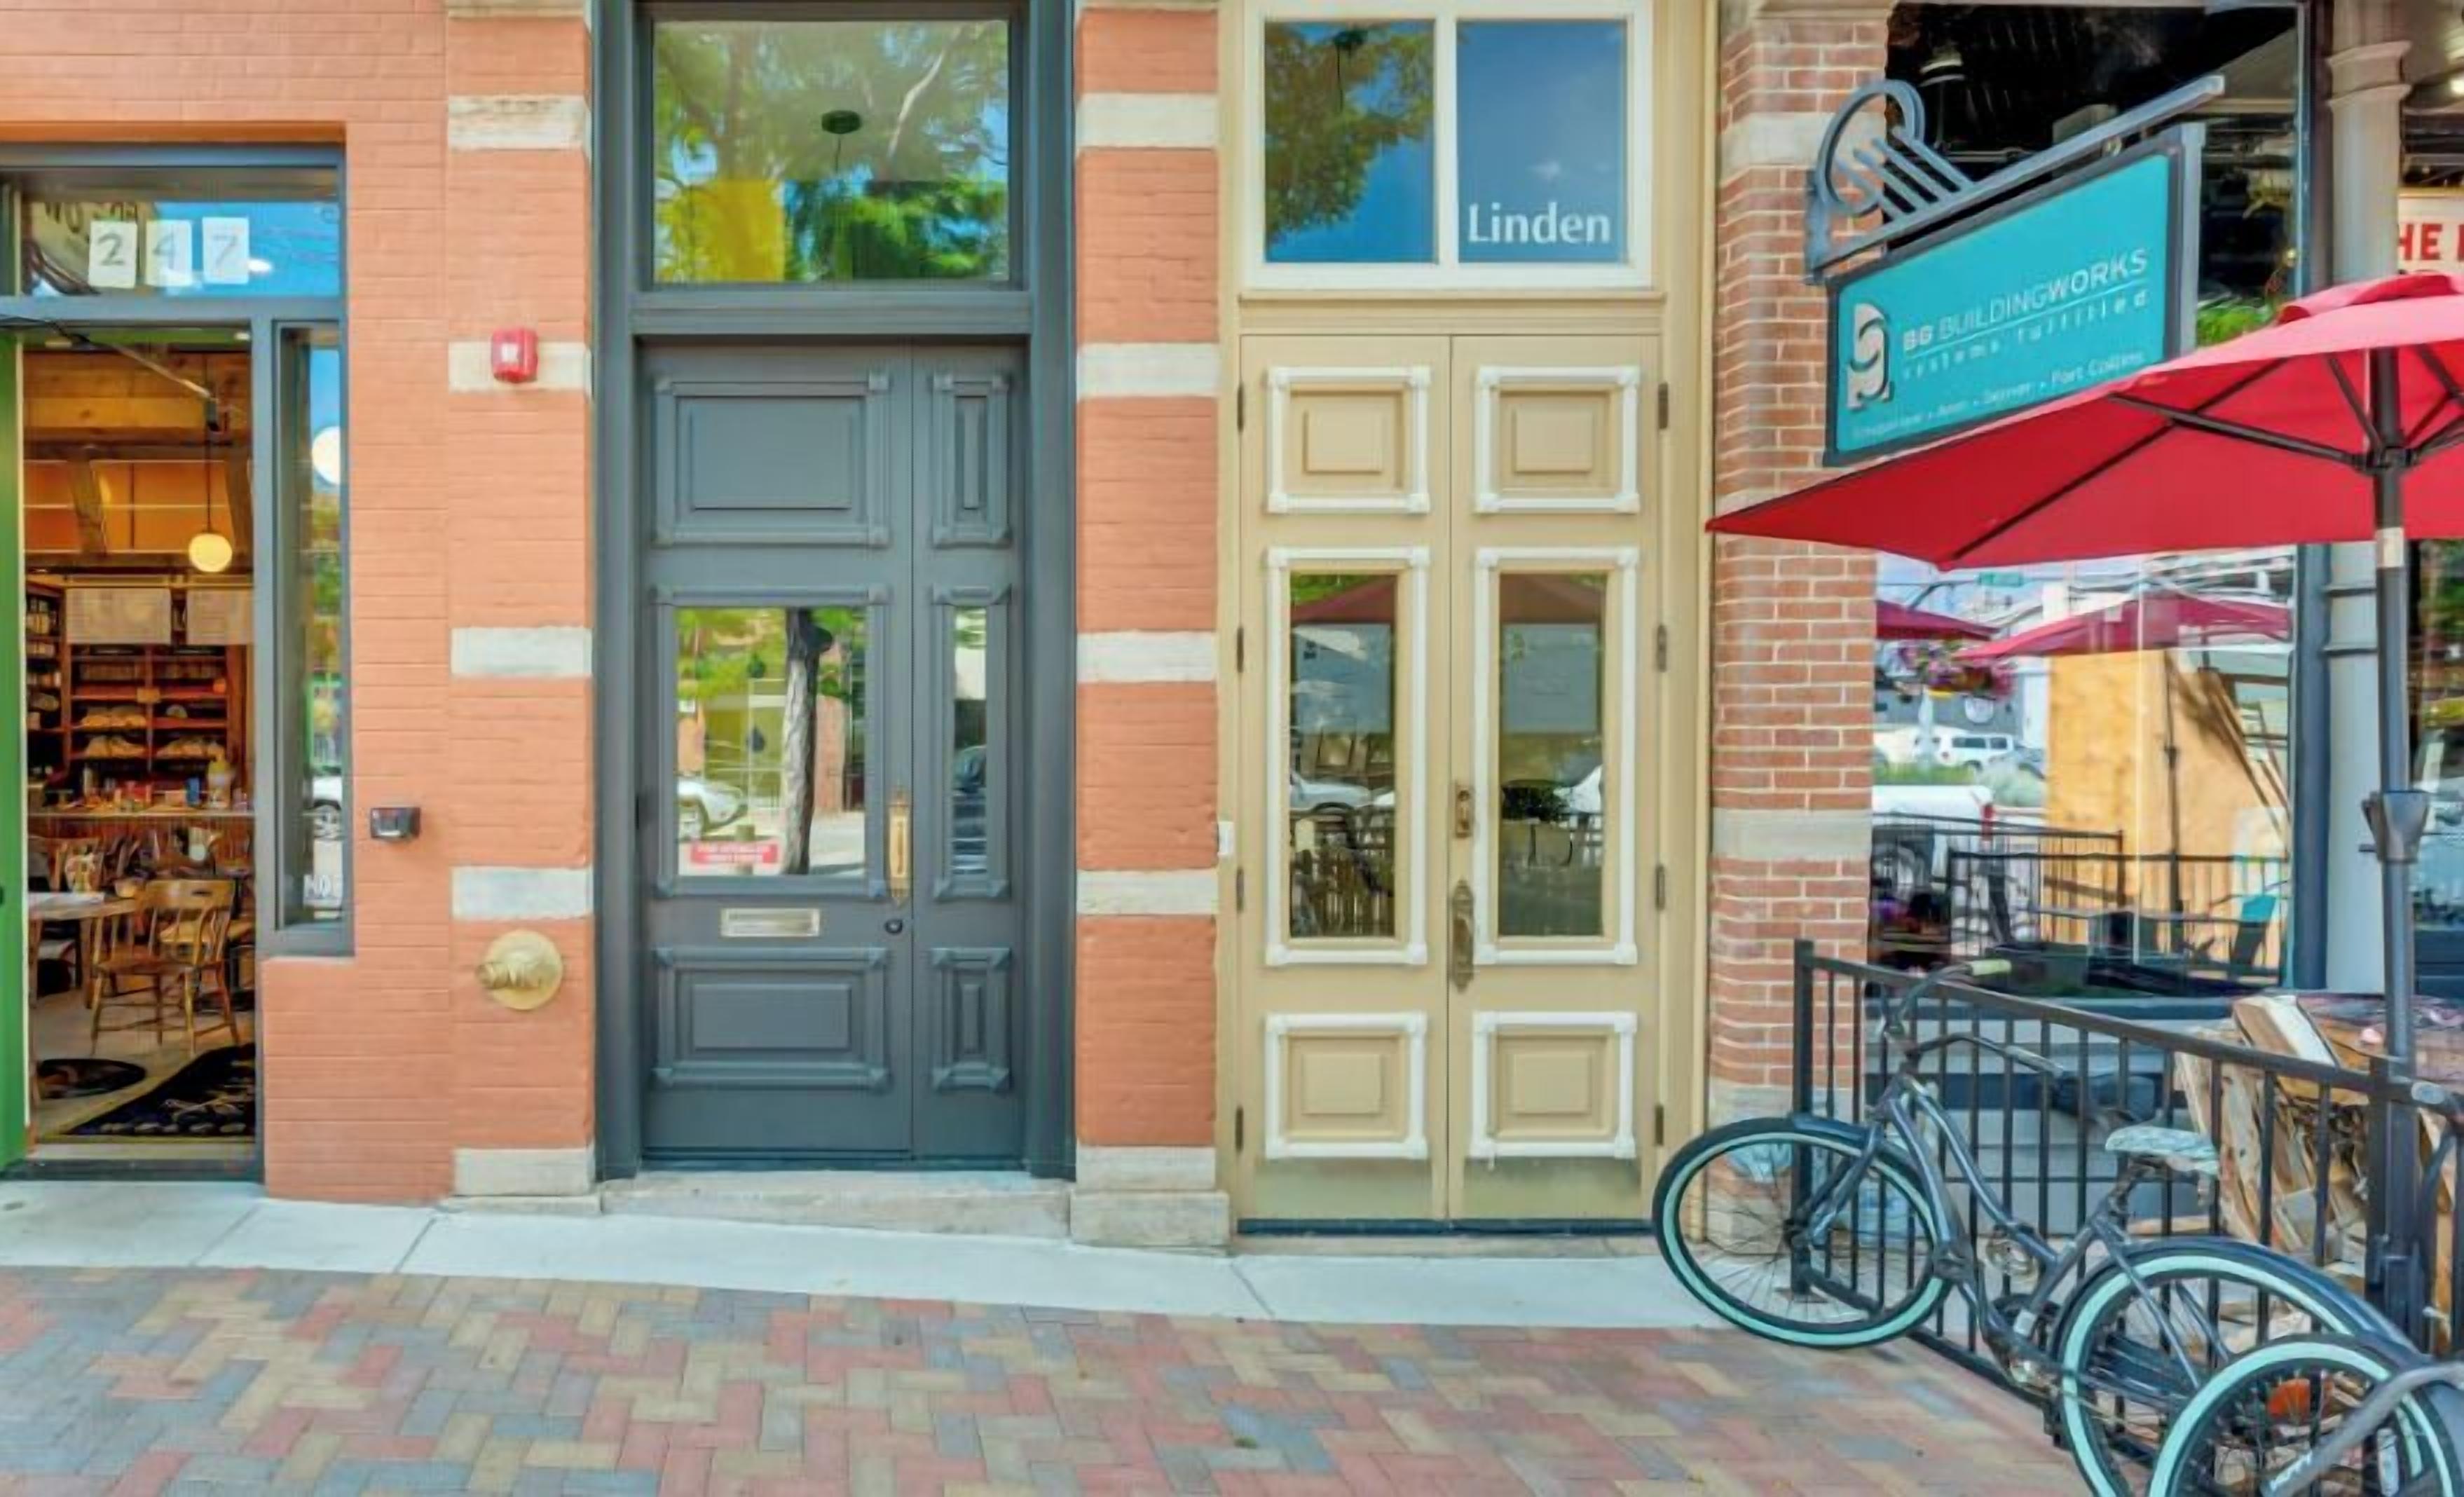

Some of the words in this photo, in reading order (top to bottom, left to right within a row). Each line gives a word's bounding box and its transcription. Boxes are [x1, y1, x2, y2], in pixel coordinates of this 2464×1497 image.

[1470, 201, 1610, 243] Linden
[96, 232, 238, 271] 247
[1939, 248, 2148, 340] BUILDINGWORKS
